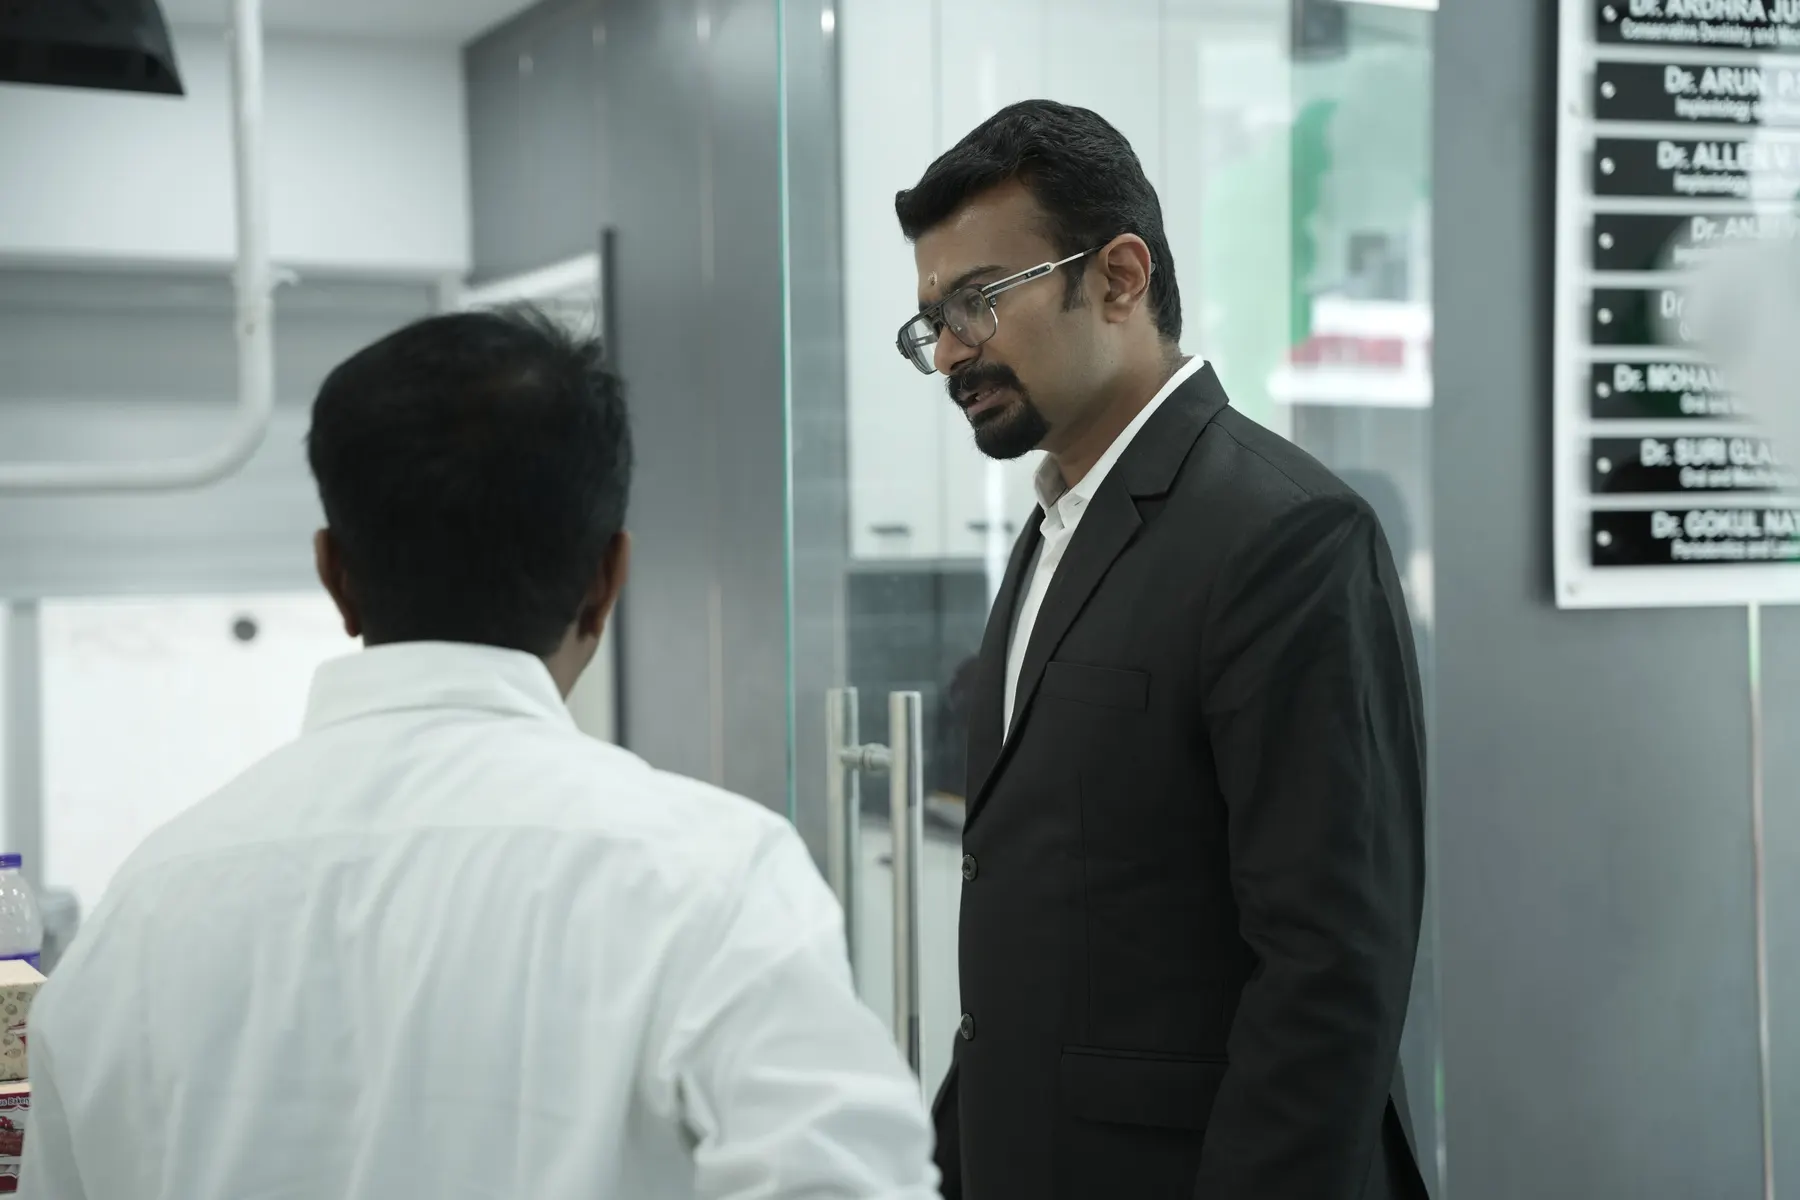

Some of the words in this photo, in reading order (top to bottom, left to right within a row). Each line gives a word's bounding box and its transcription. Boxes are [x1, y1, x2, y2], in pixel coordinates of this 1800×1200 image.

[1629, 0, 1663, 16] Dr.
[1664, 65, 1698, 95] Dr.
[1700, 67, 1768, 96] ARUN
[1656, 141, 1691, 170] Dr.
[1691, 216, 1721, 241] Dr.
[1613, 364, 1646, 393] Dr.
[1640, 439, 1673, 467] Dr.
[1729, 438, 1780, 465] GLA
[1651, 510, 1684, 539] Dr.
[1684, 510, 1761, 537] GOKUL
